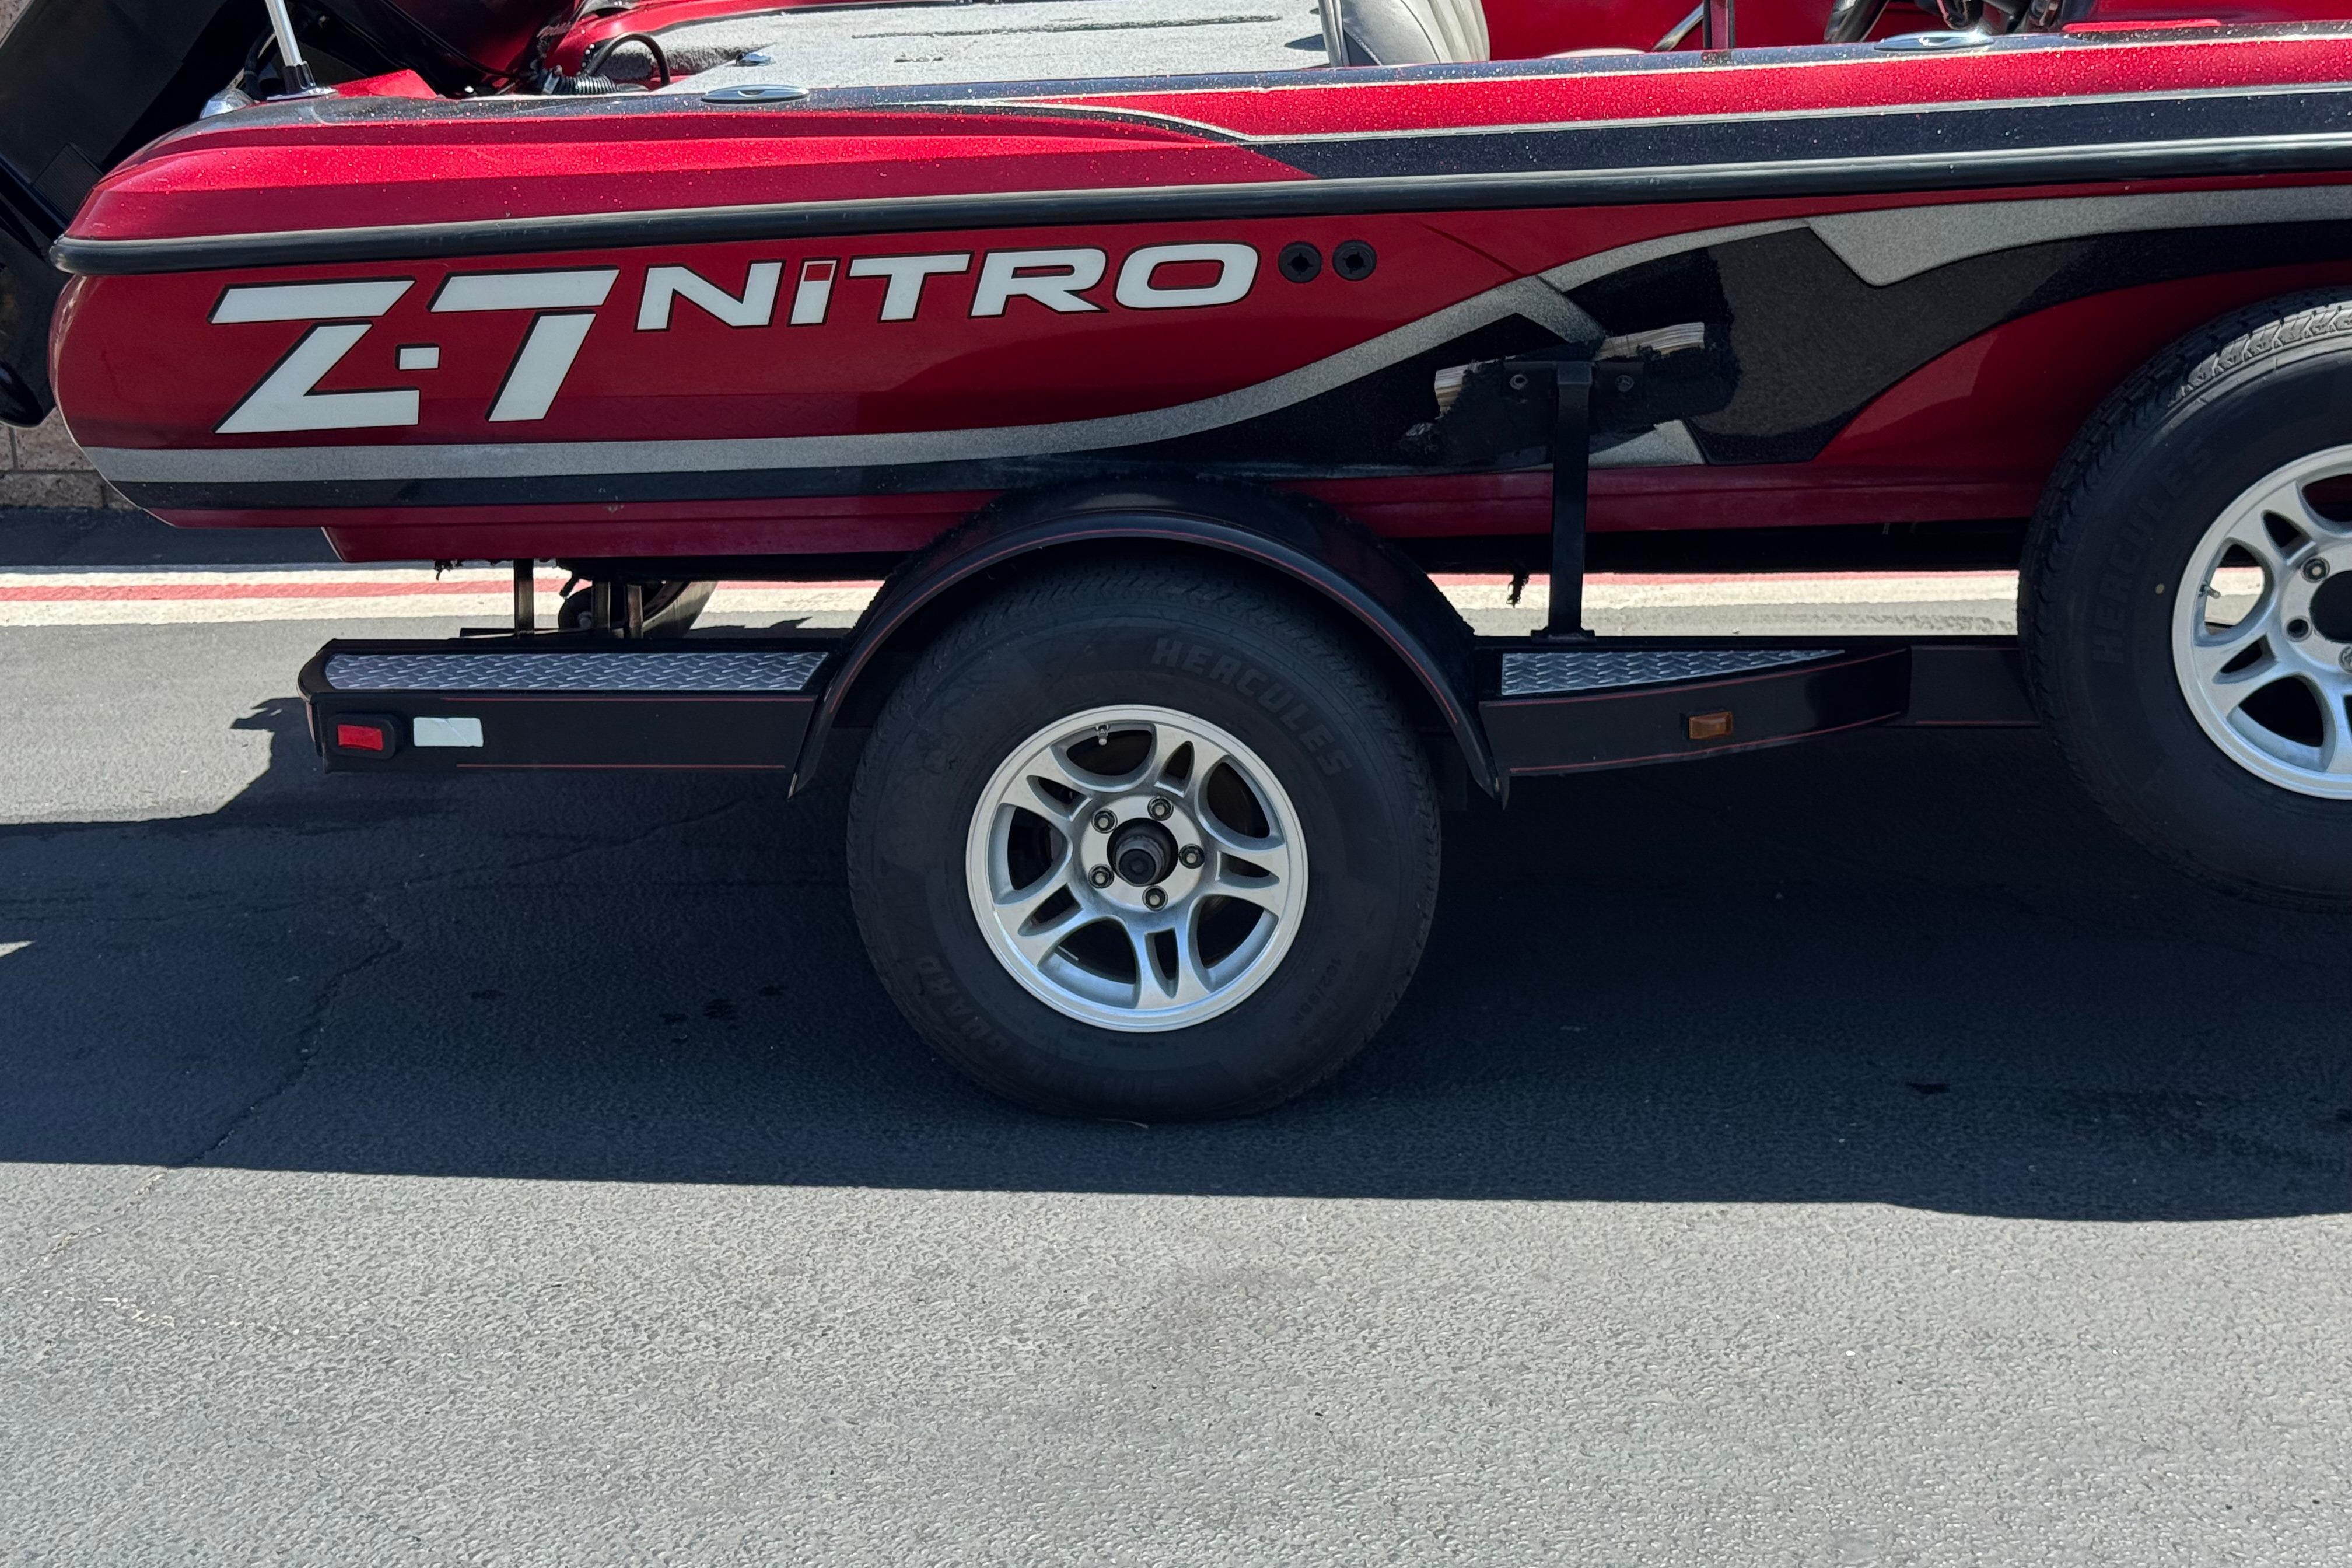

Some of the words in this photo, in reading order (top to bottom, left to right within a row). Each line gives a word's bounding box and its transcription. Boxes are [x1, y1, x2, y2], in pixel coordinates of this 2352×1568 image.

[2092, 439, 2212, 664] HERCULES
[1150, 638, 1352, 777] HERCULES
[914, 955, 1013, 1052] GUARD
